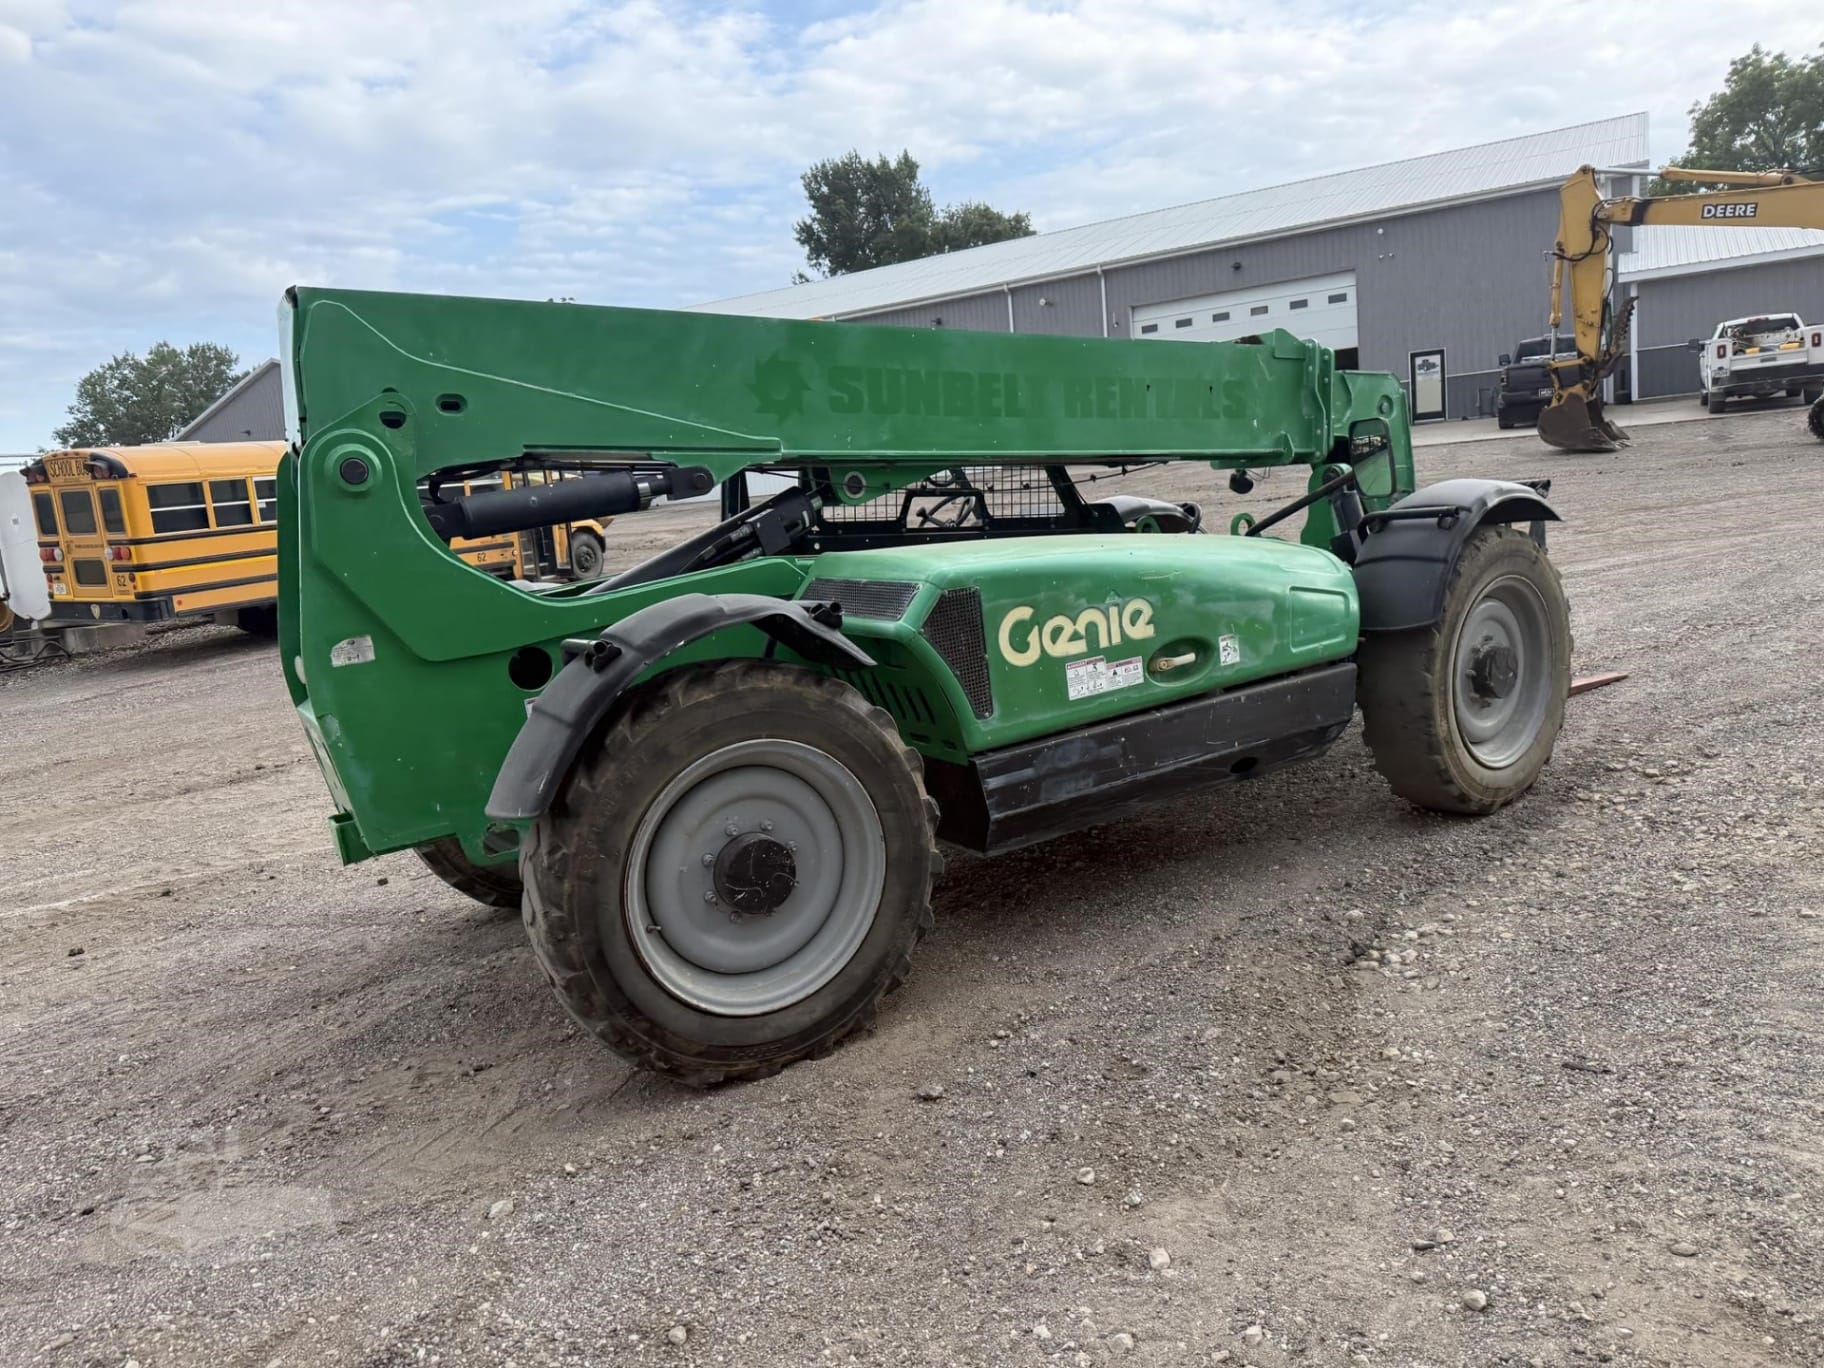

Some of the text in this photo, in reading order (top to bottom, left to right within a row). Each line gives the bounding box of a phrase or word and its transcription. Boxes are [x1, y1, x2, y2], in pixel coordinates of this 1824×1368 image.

[1703, 203, 1756, 218] DEERE
[827, 366, 1050, 419] SUNBELT
[49, 461, 75, 477] SCHOOL
[998, 598, 1155, 667] Genie
